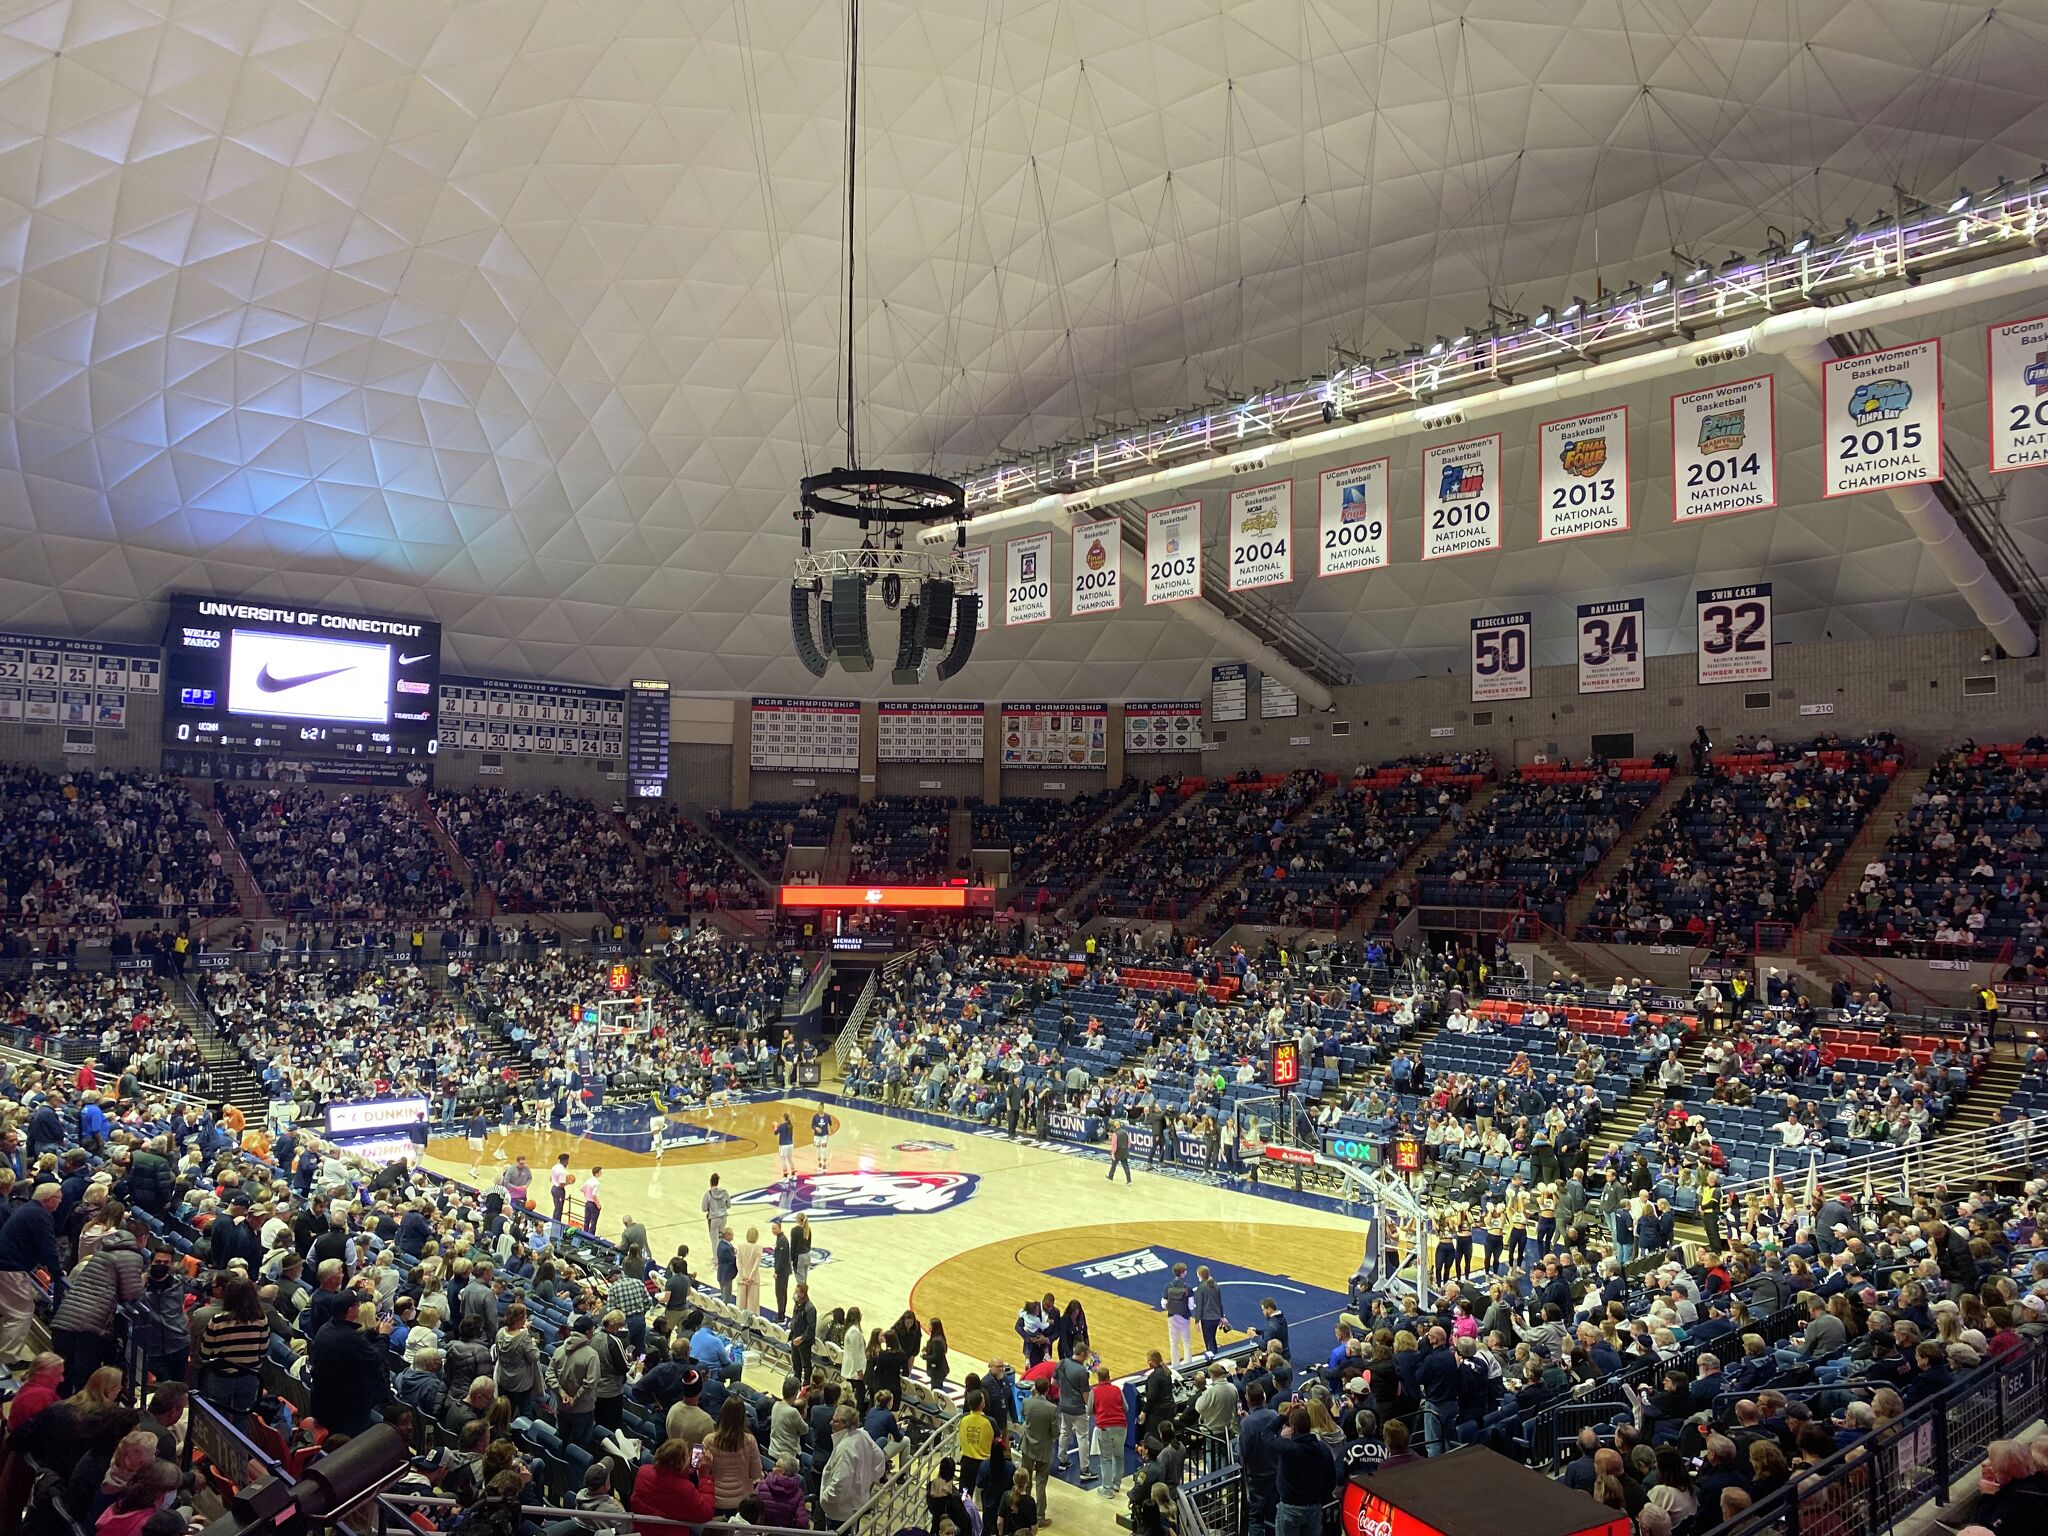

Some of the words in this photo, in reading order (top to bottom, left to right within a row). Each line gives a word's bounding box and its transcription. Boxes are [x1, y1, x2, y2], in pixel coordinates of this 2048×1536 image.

[2002, 322, 2043, 336] UConn
[1835, 358, 1871, 371] UConn
[1875, 346, 1927, 361] Women's
[1852, 361, 1910, 380] Basketball
[1682, 391, 1713, 405] UConn
[1717, 381, 1762, 398] Women's
[1696, 396, 1747, 413] Basketball
[1548, 421, 1576, 433] UConn
[1579, 412, 1618, 427] Women's
[1857, 411, 1882, 425] TAMPA
[1884, 410, 1900, 418] BAY
[1562, 425, 1605, 440] Basketball
[1840, 423, 1922, 459] 2015
[1431, 446, 1455, 457] UConn
[1458, 439, 1493, 453] Women's
[1442, 450, 1481, 464] Basketball
[1687, 453, 1760, 486] 2014
[1844, 454, 1920, 474] NATIONAL
[1326, 471, 1348, 480] UConn
[1350, 462, 1381, 475] Women's
[1336, 474, 1371, 487] Basketball
[1838, 468, 1927, 489] CHAMPIONS
[1236, 491, 1256, 500] UConn
[1258, 483, 1286, 495] Women's
[1552, 479, 1615, 509] 2013
[1691, 482, 1757, 500] NATIONAL
[1245, 494, 1276, 507] Basketball
[1686, 495, 1763, 515] CHAMPIONS
[1152, 510, 1169, 518] UConn
[1170, 505, 1196, 515] Women's
[1432, 502, 1490, 530] 2010
[1555, 505, 1612, 522] NATIONAL
[1077, 524, 1093, 533] UConn
[1095, 520, 1116, 530] Women's
[1160, 514, 1188, 526] Basketball
[1435, 526, 1486, 541] NATIONAL
[1550, 518, 1617, 536] CHAMPIONS
[1028, 535, 1047, 545] Women's
[1085, 529, 1109, 539] Basketball
[1326, 521, 1382, 548] 2009
[1017, 544, 1040, 553] Basketball
[1235, 539, 1286, 564] 2004
[1330, 546, 1376, 559] NATIONAL
[1432, 538, 1491, 555] CHAMPIONS
[1151, 558, 1195, 580] 2003
[1240, 562, 1280, 576] NATIONAL
[1327, 556, 1380, 572] CHAMPIONS
[1076, 571, 1116, 591] 2002
[1155, 579, 1191, 590] NATIONAL
[1237, 572, 1284, 587] CHAMPIONS
[1009, 583, 1048, 603] 2000
[1080, 591, 1112, 600] NATIONAL
[1152, 588, 1194, 601] CHAMPIONS
[1712, 591, 1732, 600] SWIN
[1735, 588, 1756, 597] CASH
[1014, 603, 1043, 612] NATIONAL
[1077, 600, 1114, 610] CHAMPIONS
[1591, 606, 1604, 614] RAY
[1607, 603, 1629, 612] ALLEN
[200, 602, 294, 622] UNIVERSITY
[298, 613, 317, 625] OF
[322, 615, 421, 637] CONNECTICUT
[1011, 611, 1046, 622] CHAMPIONS
[1477, 618, 1505, 627] REBECCA
[1507, 616, 1524, 624] LOBO
[183, 628, 220, 639] WELLS
[1704, 602, 1765, 654] 32
[183, 637, 219, 648] FARGO
[1584, 616, 1638, 665] 34
[1476, 629, 1525, 675] 50
[32, 665, 54, 680] 42
[70, 669, 86, 682] 25
[106, 671, 118, 685] 33
[140, 674, 150, 687] 10
[183, 688, 212, 699] CBS
[446, 700, 455, 711] 32
[473, 702, 477, 712] 3
[519, 705, 528, 716] 20
[543, 707, 550, 718] 31
[564, 709, 573, 720] 23
[586, 711, 595, 721] 31
[609, 713, 617, 723] 14
[178, 724, 189, 739] 0
[199, 722, 218, 731] UCONN
[301, 728, 326, 739] 6:21
[442, 731, 456, 743] 23
[470, 733, 477, 744] 4
[428, 740, 437, 753] 0
[492, 735, 505, 746] 30
[519, 736, 525, 747] 3
[539, 738, 551, 749] CD
[563, 740, 572, 750] 15
[583, 741, 597, 752] 24
[356, 744, 362, 752] 0
[605, 743, 619, 753] 33
[640, 786, 662, 796] 6:20
[1951, 961, 1969, 970] 211
[613, 975, 624, 987] 30
[1501, 988, 1516, 996] 110
[1668, 1000, 1684, 1009] 110
[584, 1012, 597, 1022] COX
[1279, 1046, 1293, 1059] 6:21
[1277, 1060, 1292, 1080] 30
[1335, 1140, 1370, 1160] COX
[1400, 1141, 1417, 1152] 6:21
[1400, 1153, 1414, 1165] 30
[1111, 1260, 1168, 1279] BIG
[2009, 1373, 2024, 1394] SEC
[1344, 1444, 1391, 1465] UCON
